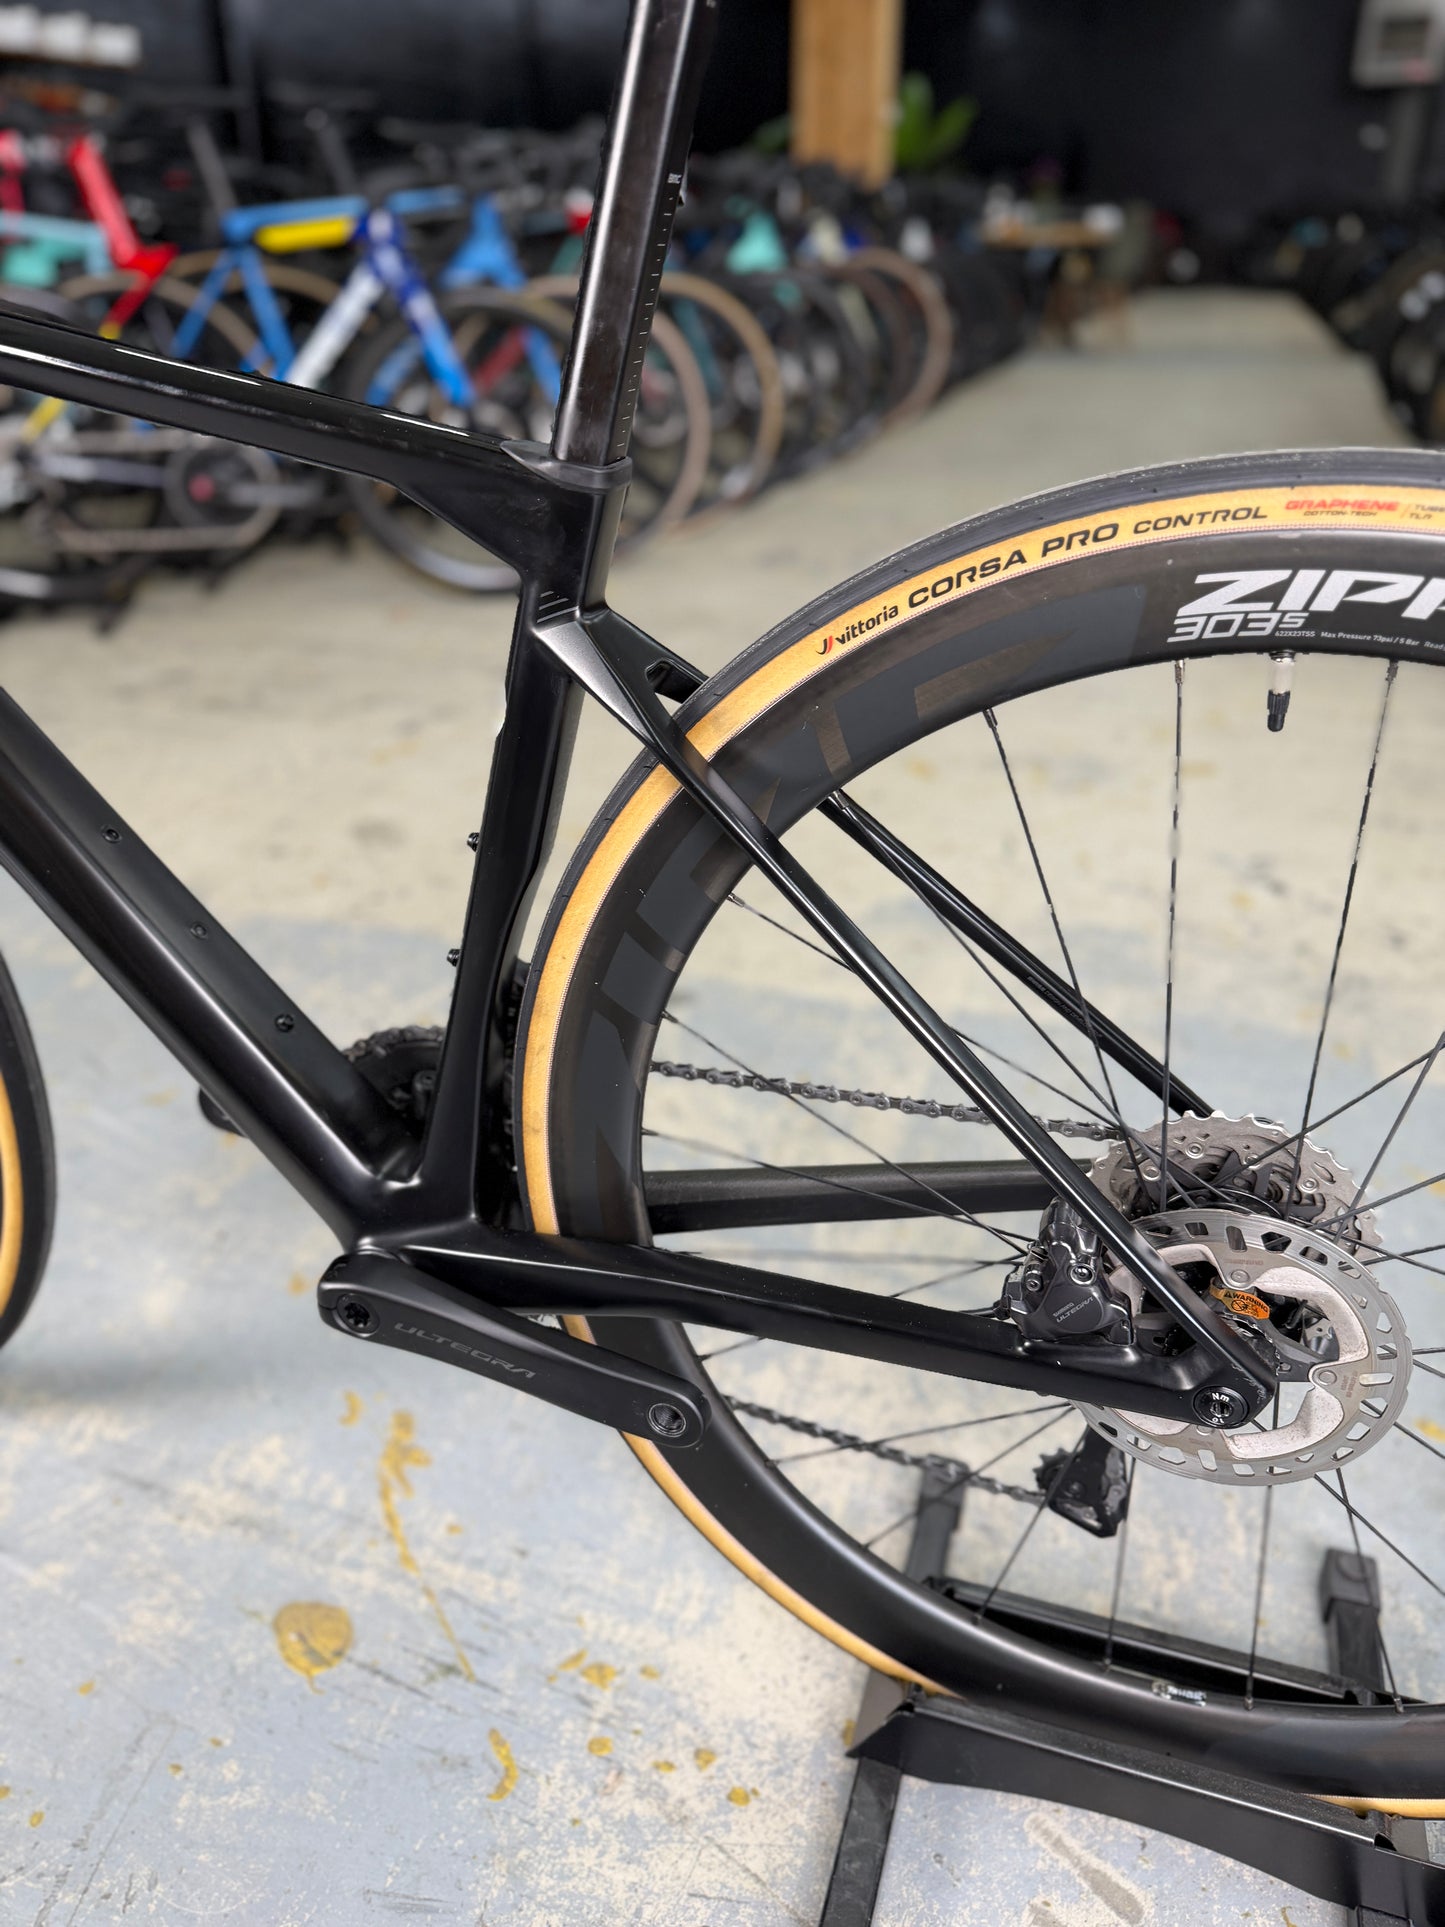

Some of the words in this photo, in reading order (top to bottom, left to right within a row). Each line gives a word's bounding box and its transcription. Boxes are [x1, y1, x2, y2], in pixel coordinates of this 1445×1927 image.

[1285, 499, 1399, 512] GRAPHENE
[836, 605, 899, 645] vittoria
[908, 549, 1027, 609] CORSA
[1041, 523, 1119, 558] PRO
[1133, 506, 1268, 535] CONTROL
[1320, 631, 1336, 639] Max
[1337, 632, 1372, 641] Pressure
[1405, 638, 1420, 646] Bar
[1232, 1292, 1269, 1313] WARNING
[394, 1322, 537, 1379] ULTEGRA
[1211, 1392, 1230, 1402] Nm
